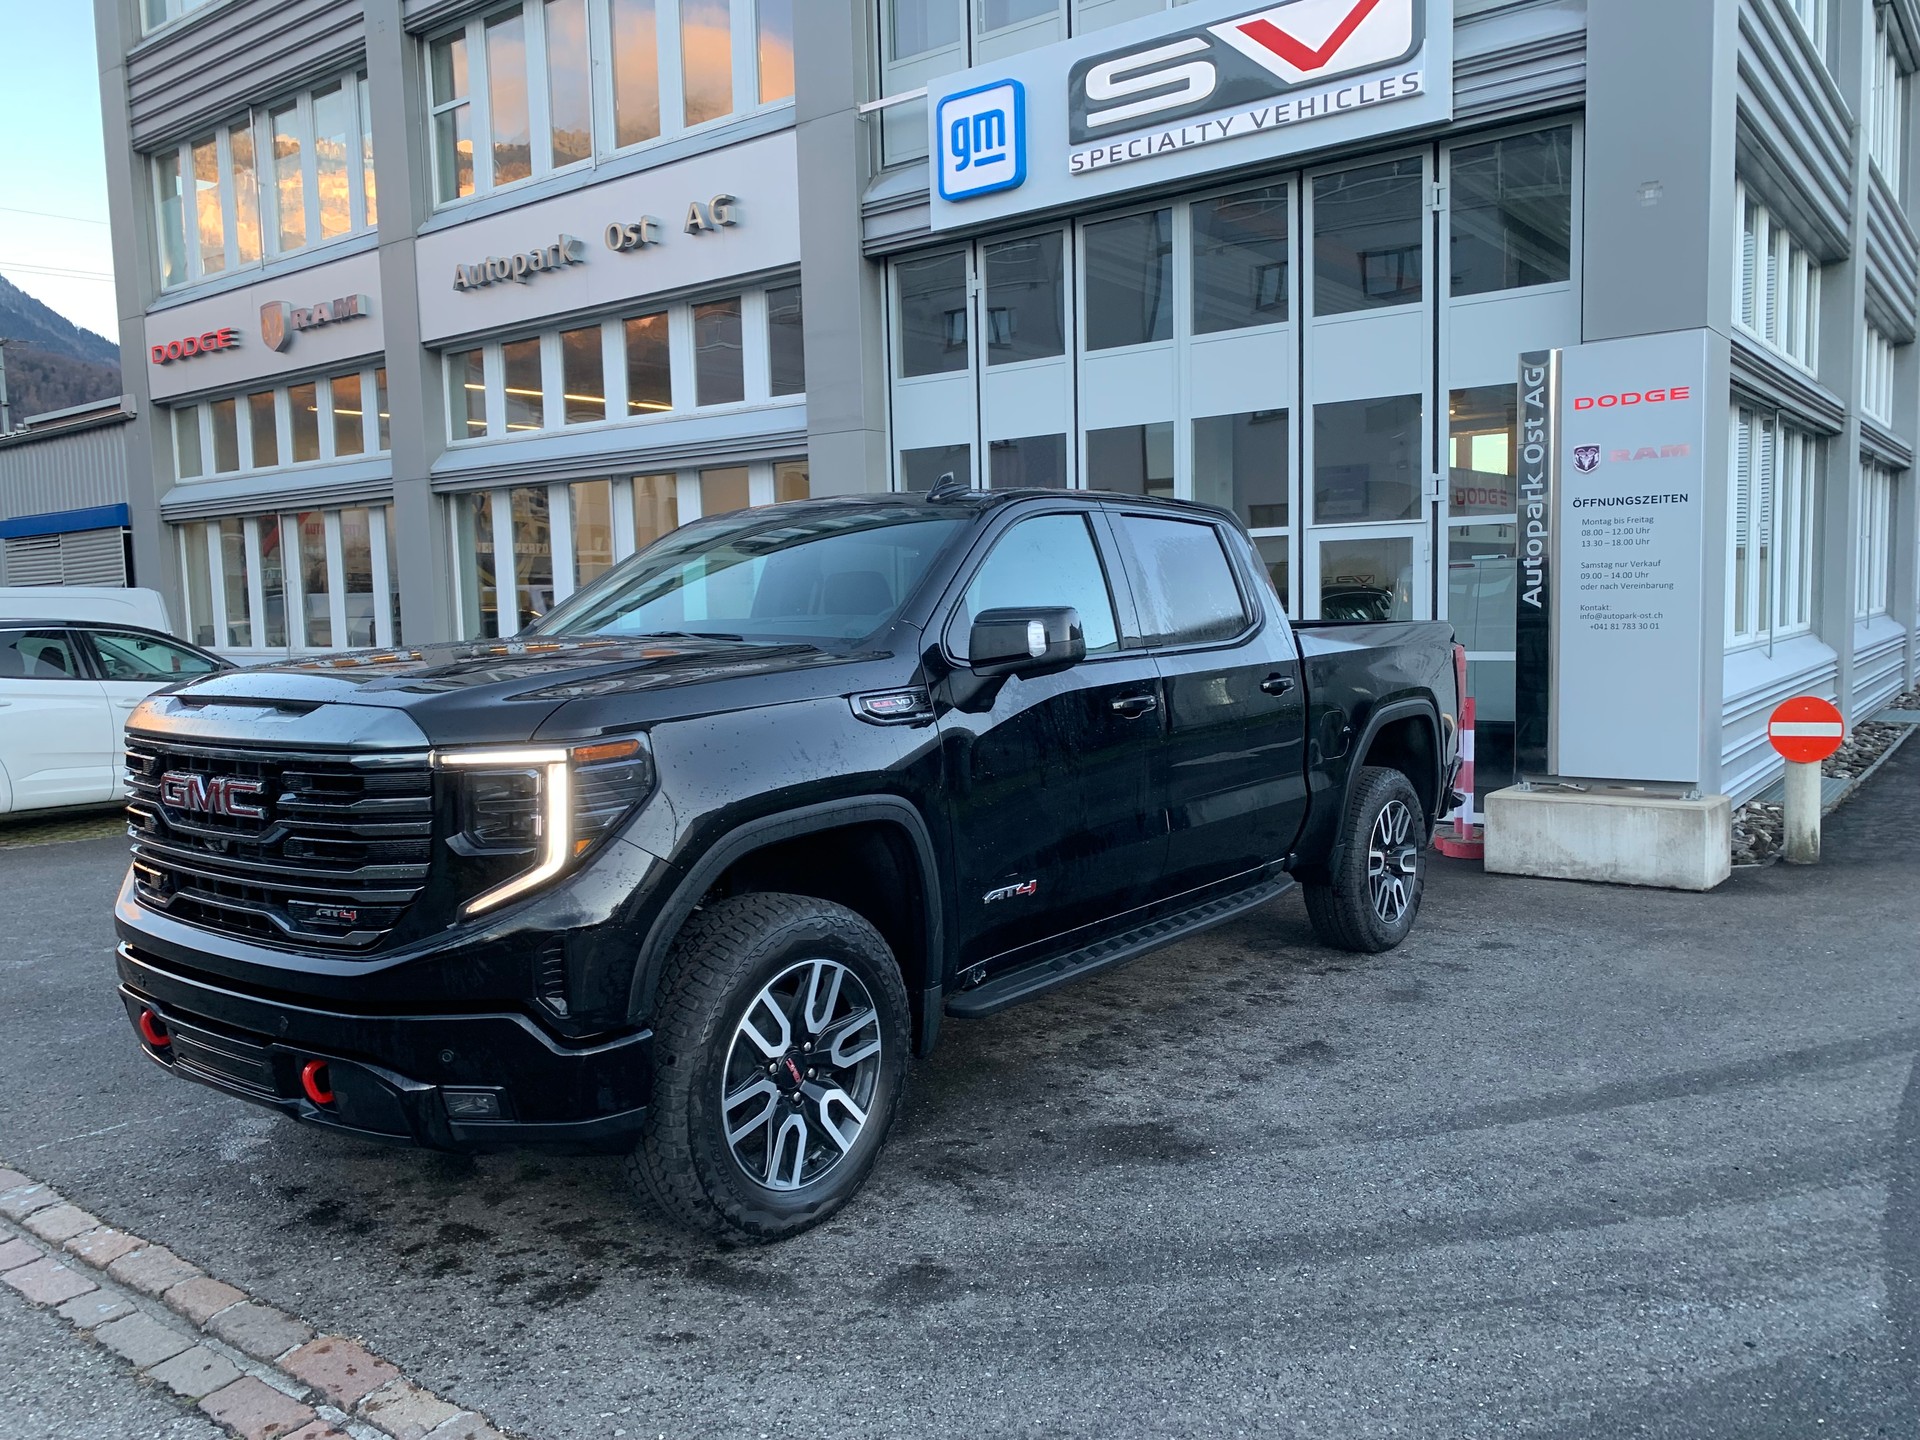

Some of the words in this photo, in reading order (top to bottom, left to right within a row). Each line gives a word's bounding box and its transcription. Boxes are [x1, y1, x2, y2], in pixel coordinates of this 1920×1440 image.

[1071, 117, 1234, 172] SPECIALTY
[1249, 72, 1419, 129] VEHICLES
[951, 108, 1006, 172] gm
[452, 233, 584, 292] Autopark
[604, 214, 659, 252] Ost
[683, 193, 737, 235] AG
[290, 294, 366, 331] RAM
[151, 327, 239, 364] DODGE
[1523, 366, 1545, 409] AG
[1574, 387, 1690, 410] DODGE
[1523, 417, 1545, 465] Ost
[1609, 444, 1690, 462] RAM
[1456, 488, 1508, 507] DODGE
[1572, 493, 1689, 508] ÖFFNUNGSZEITEN
[1581, 518, 1612, 527] Montag
[1613, 517, 1625, 525] bis
[1626, 516, 1655, 525] Freitag
[1521, 471, 1548, 609] Autopark
[1581, 528, 1603, 537] 08.00
[1612, 527, 1634, 536] 12.00
[1635, 527, 1650, 535] Uhr
[1581, 539, 1603, 548] 13.30
[1612, 538, 1634, 547] 18.00
[1635, 538, 1650, 546] Uhr
[1580, 561, 1613, 570] Samstag
[1629, 559, 1662, 568] Verkauf
[1580, 572, 1602, 580] 09.00
[1611, 571, 1633, 579] 14.00
[1634, 571, 1649, 579] Uhr
[1580, 582, 1598, 590] oder
[1599, 582, 1619, 590] nach
[1620, 582, 1675, 591] Vereinbarung
[1580, 612, 1664, 621] info@autopark-ost.ch
[1649, 622, 1660, 630] 01
[161, 770, 265, 819] GMC
[982, 880, 1037, 904] AT4
[315, 908, 357, 922] AT4
